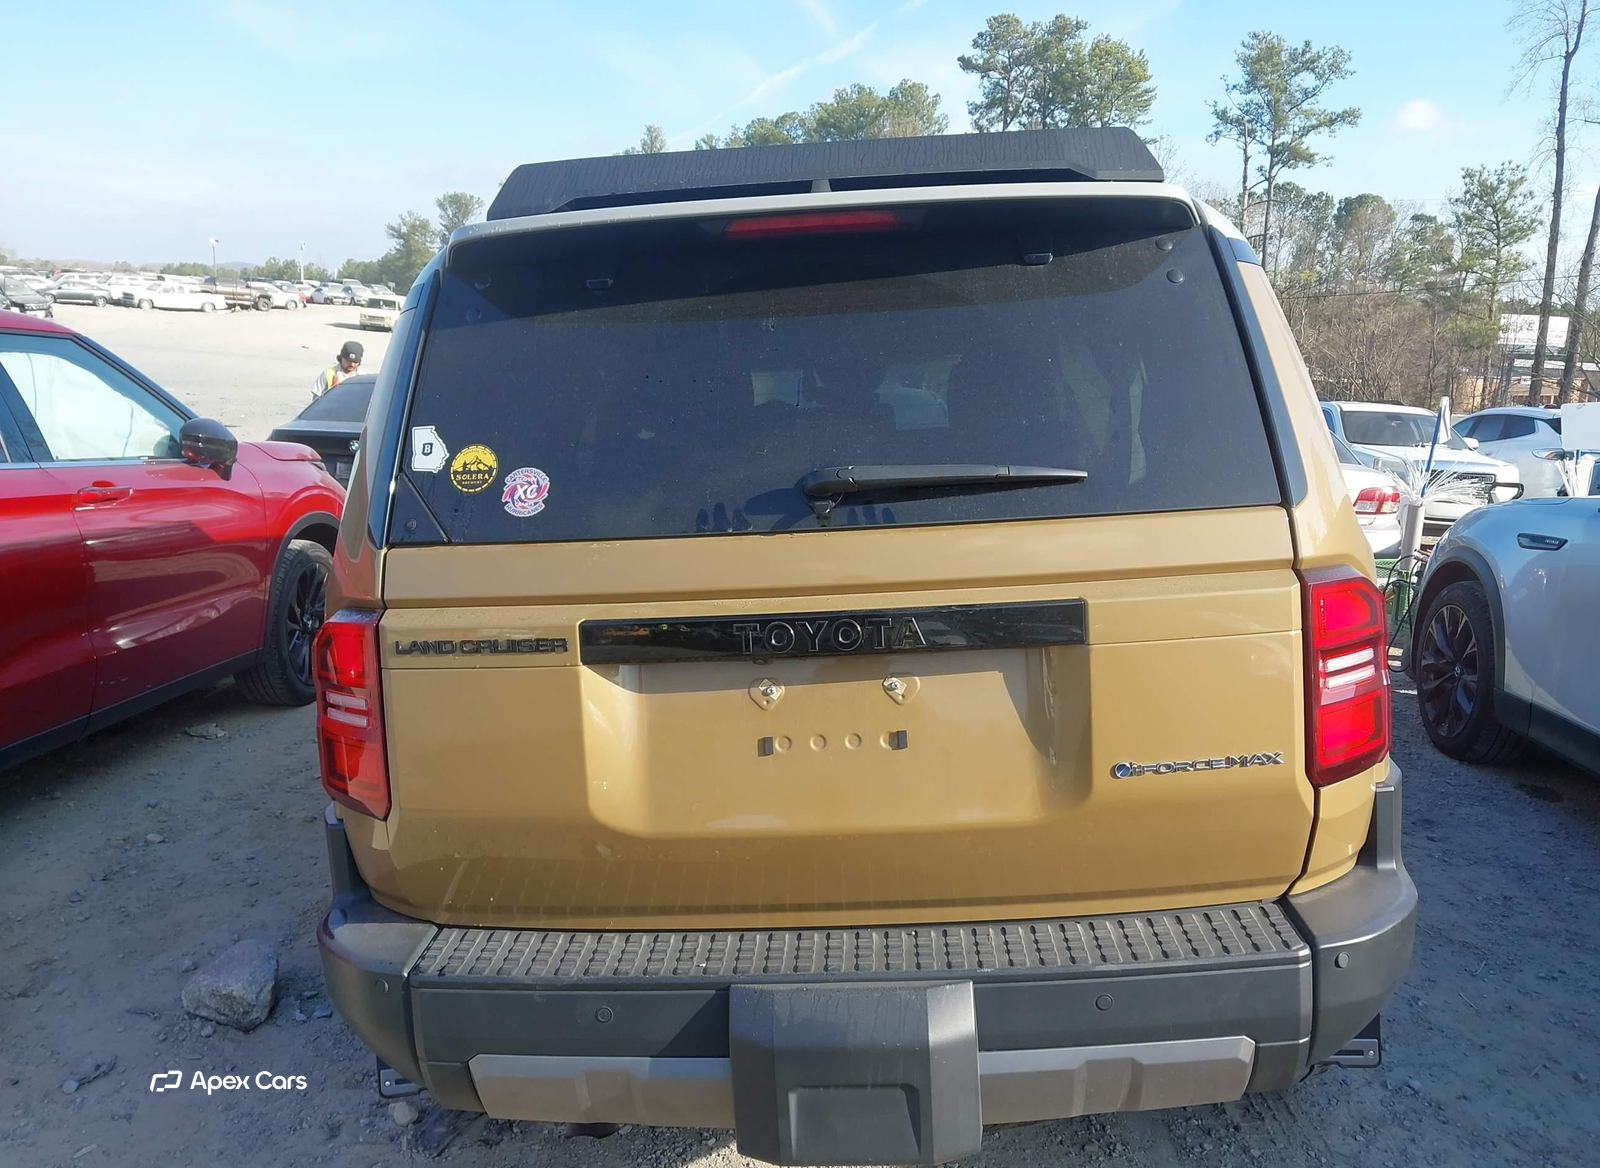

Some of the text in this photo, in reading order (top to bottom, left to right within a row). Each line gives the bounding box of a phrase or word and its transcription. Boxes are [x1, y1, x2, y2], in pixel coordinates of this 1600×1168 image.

[423, 444, 431, 453] B
[455, 473, 490, 481] SOLERA
[506, 468, 548, 483] CARTERSVILLE
[513, 484, 539, 500] XC
[505, 503, 544, 516] HURRICANES
[733, 616, 927, 655] TOYOTA
[394, 638, 569, 655] LAND CRUISER
